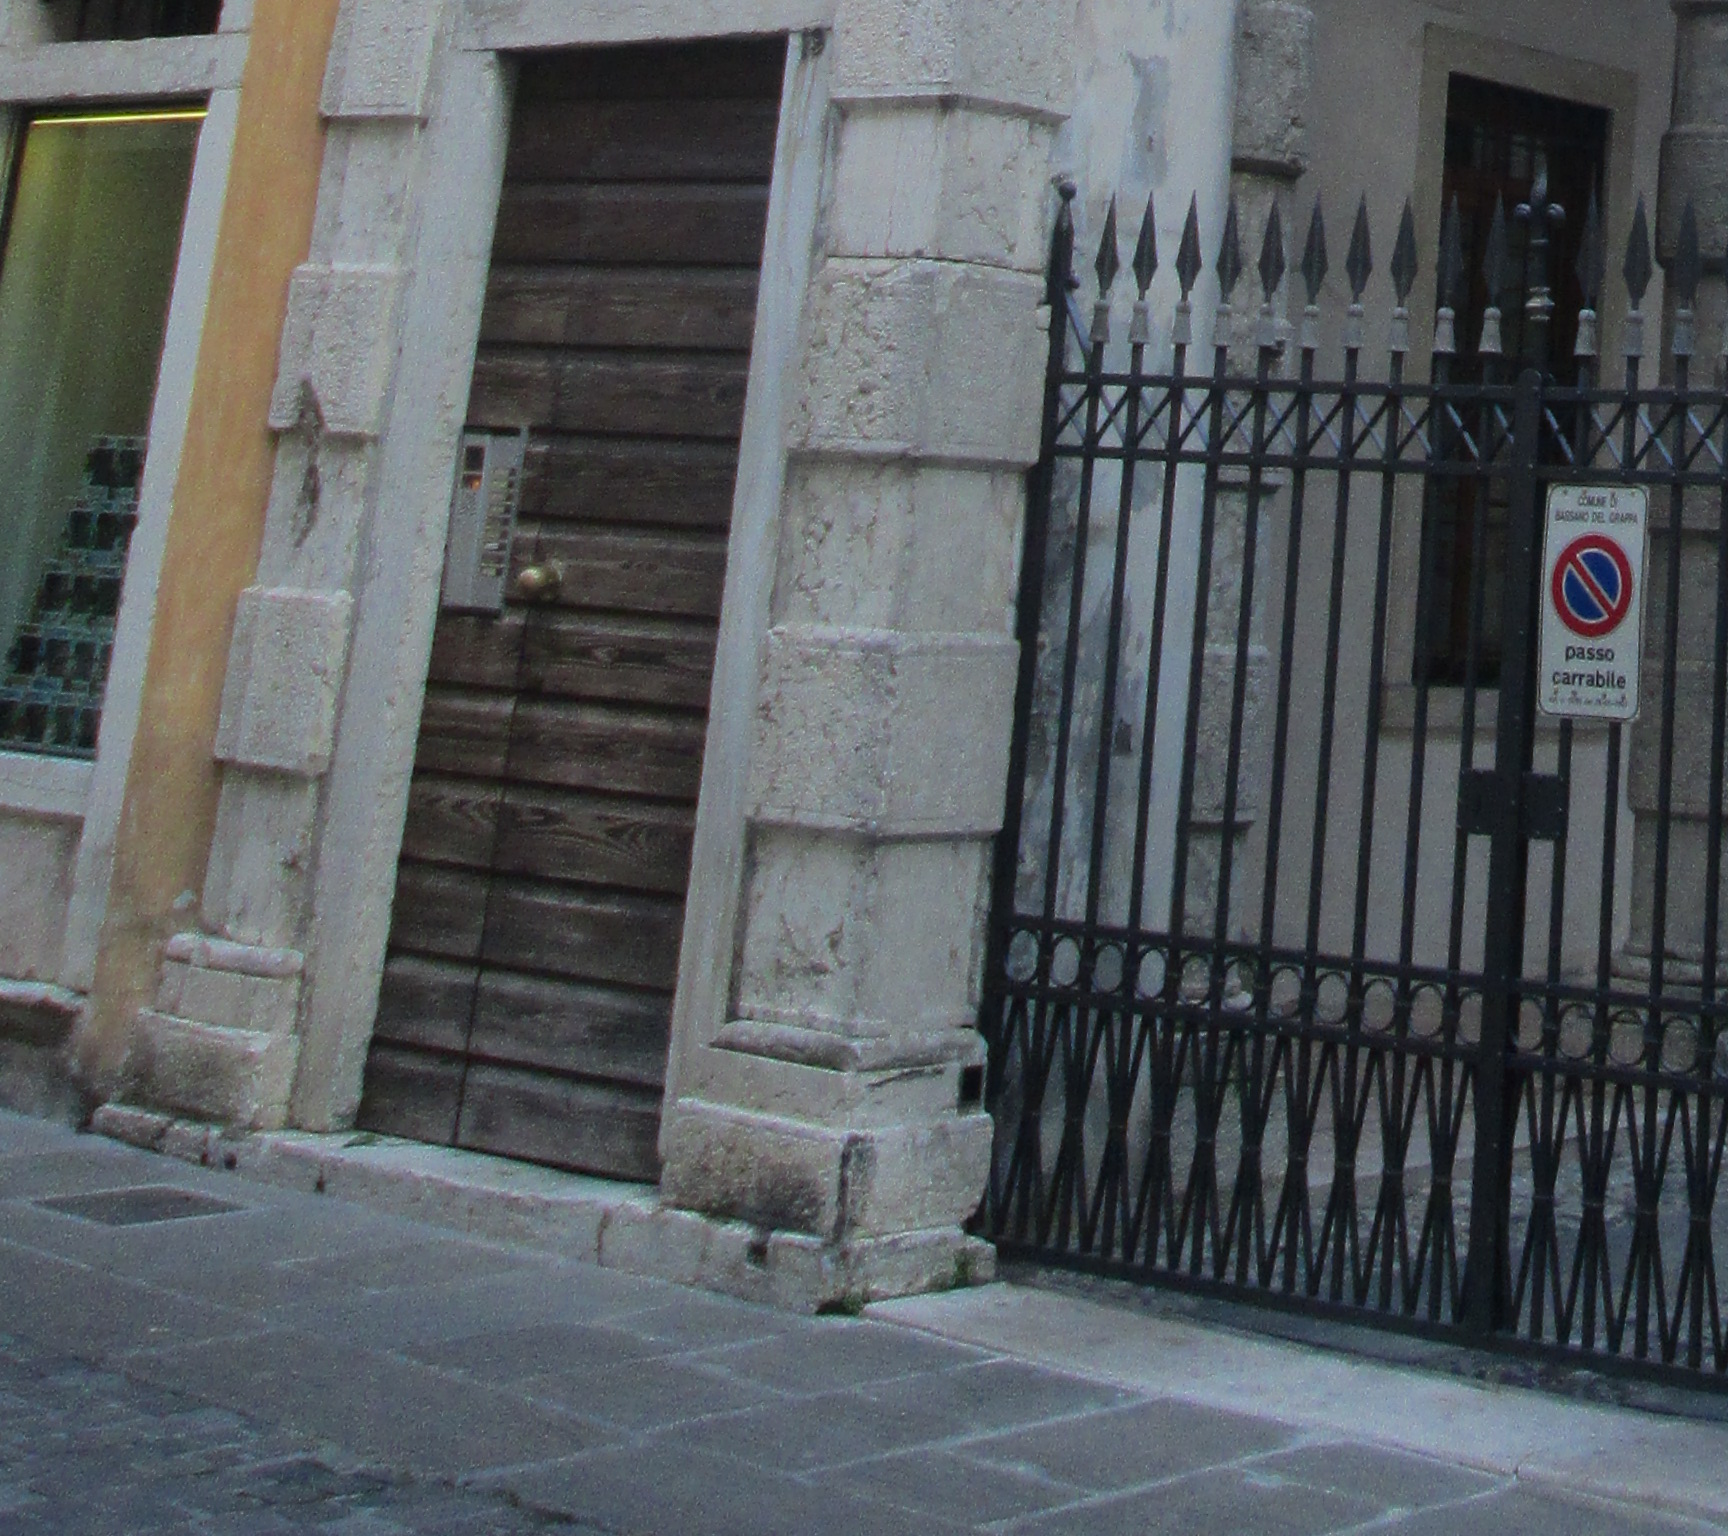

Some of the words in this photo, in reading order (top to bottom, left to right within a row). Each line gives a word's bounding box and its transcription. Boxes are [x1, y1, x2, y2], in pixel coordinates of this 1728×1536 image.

[1578, 494, 1607, 506] COMUNE
[1554, 509, 1589, 523] BASSANO
[1591, 511, 1605, 524] DEL
[1608, 511, 1639, 525] GRAPPA
[1565, 645, 1615, 662] passo
[1552, 670, 1626, 689] carrabile
